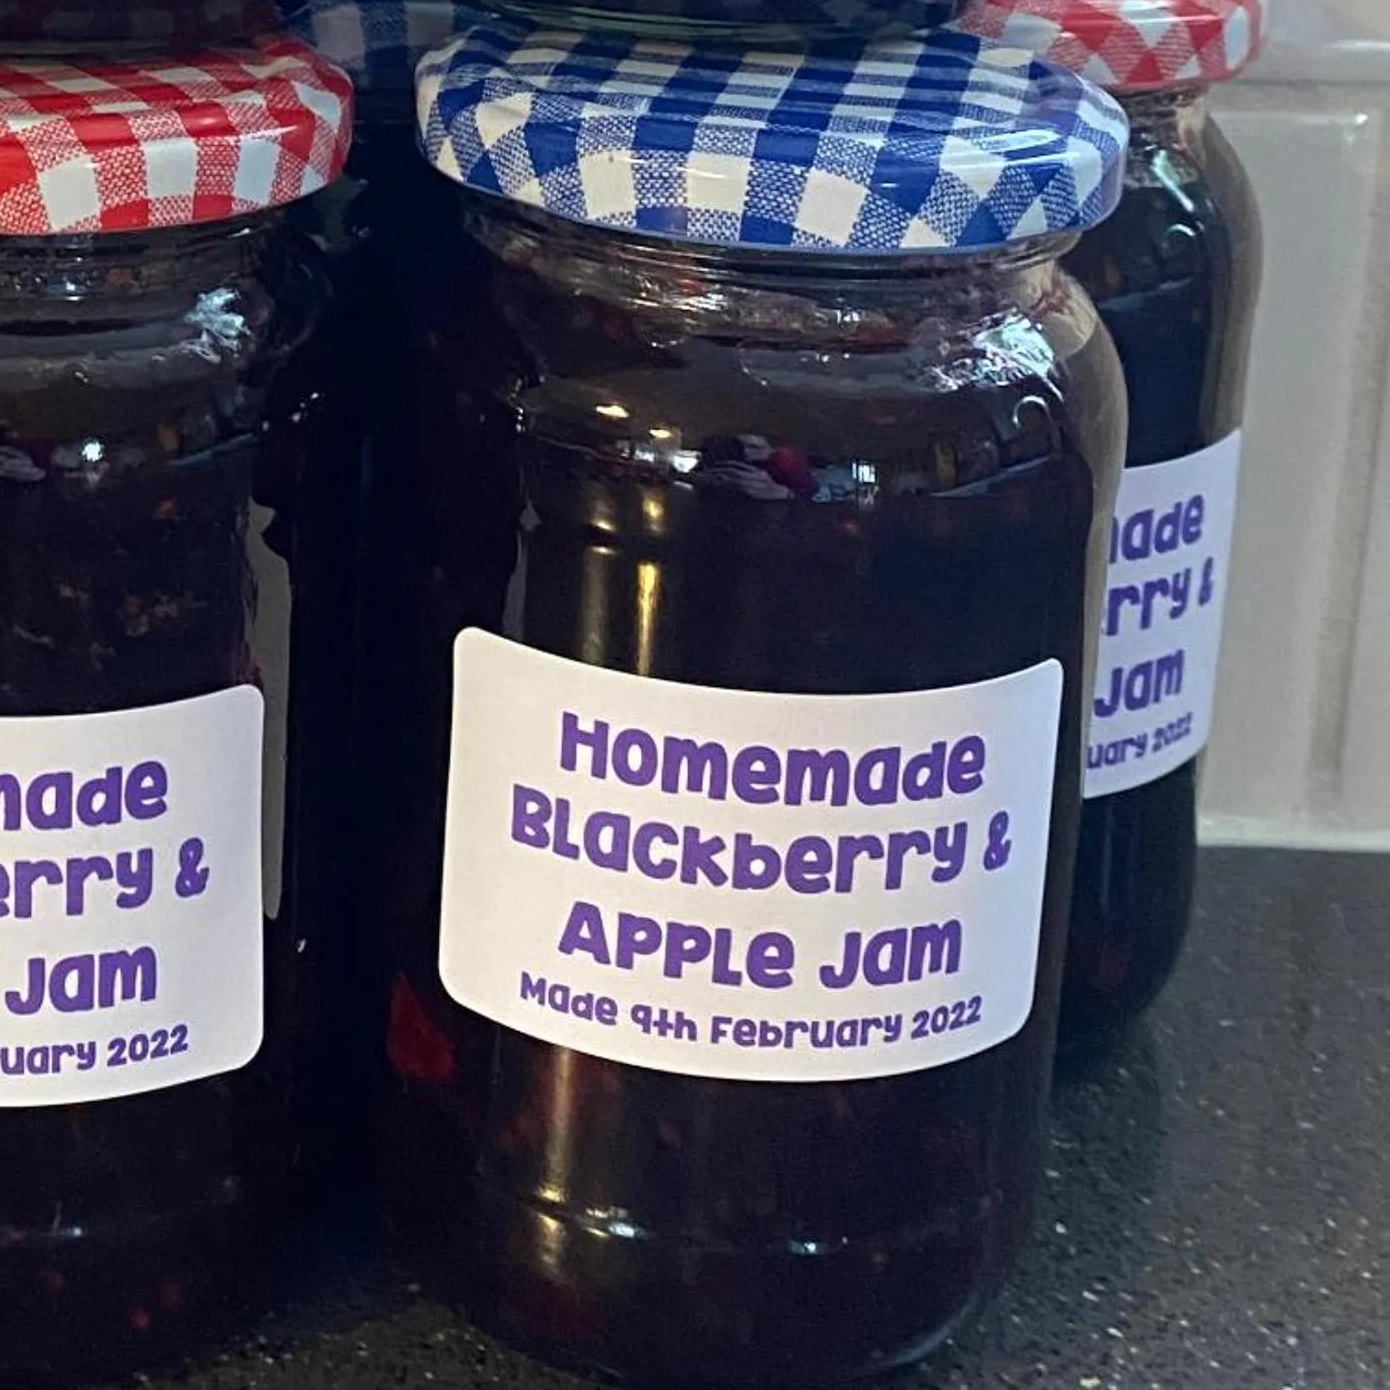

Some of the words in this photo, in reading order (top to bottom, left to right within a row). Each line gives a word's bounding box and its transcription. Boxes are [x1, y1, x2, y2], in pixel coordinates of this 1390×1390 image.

[561, 713, 986, 807] Homemade
[175, 837, 209, 898] &
[983, 810, 1012, 871] &
[5, 946, 157, 1015] Jam
[819, 919, 962, 989] Jam
[522, 974, 615, 1026] Made
[632, 1005, 697, 1039] 9th
[712, 1010, 901, 1047] February
[911, 995, 983, 1038] 2022
[107, 1024, 188, 1067] 2022
